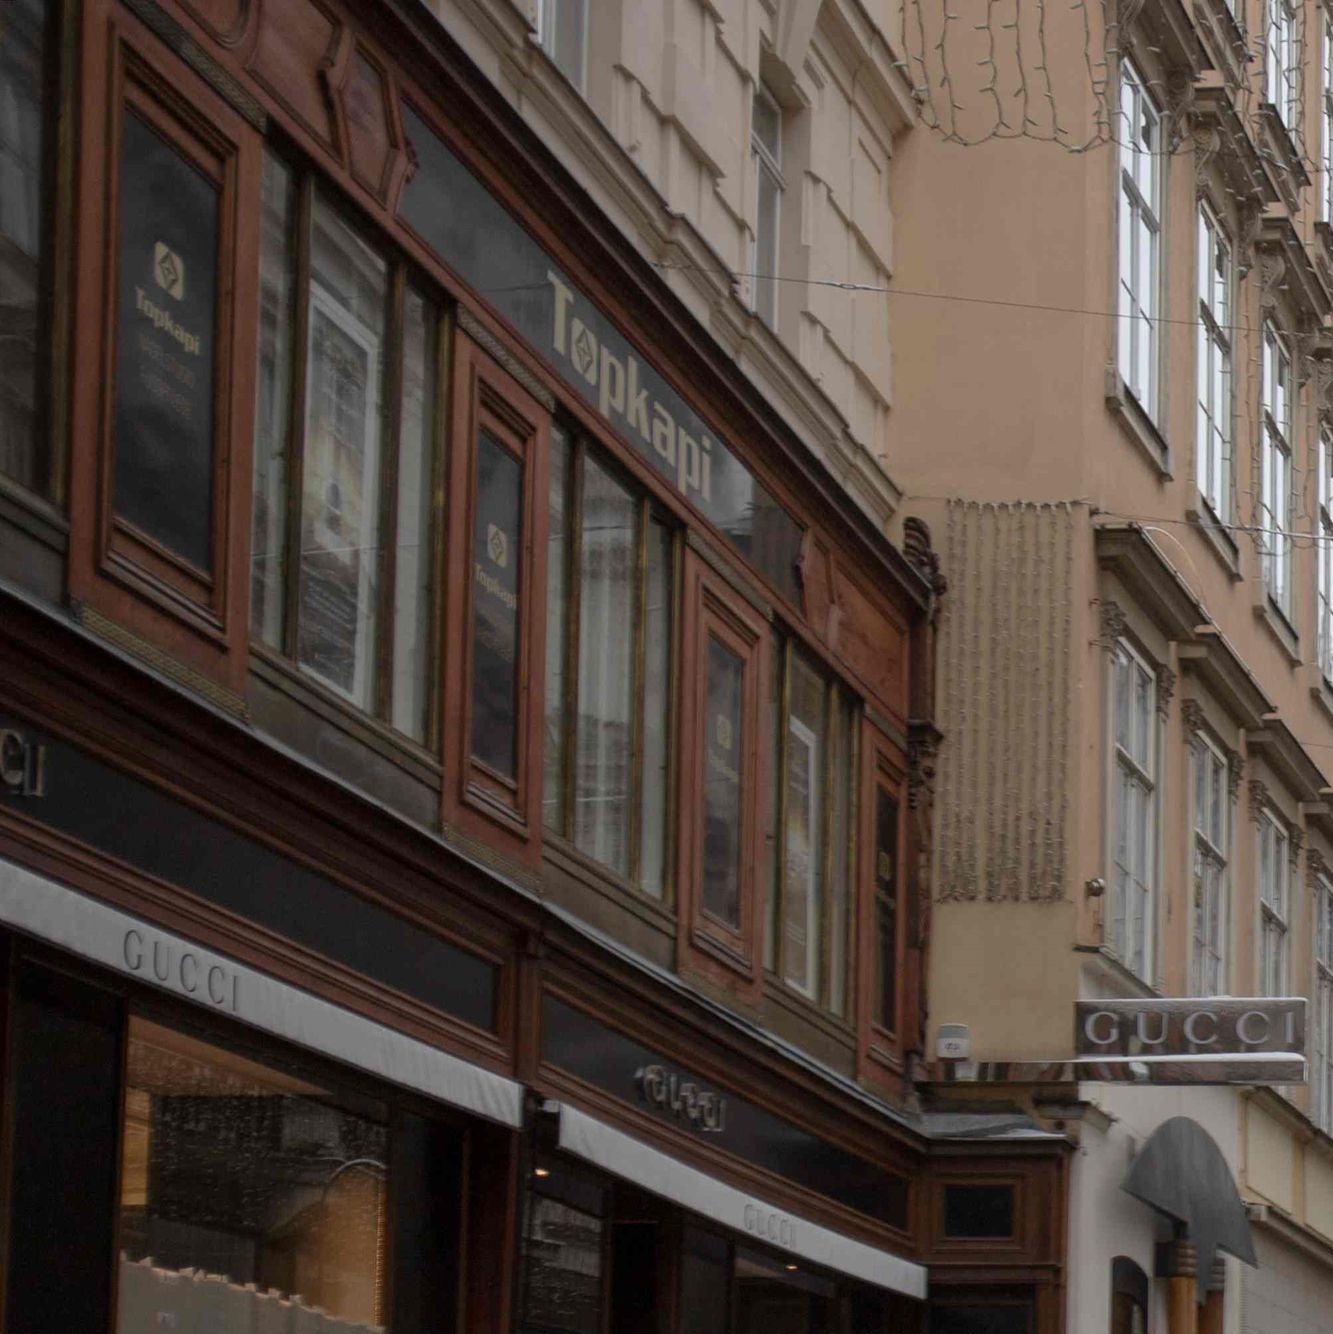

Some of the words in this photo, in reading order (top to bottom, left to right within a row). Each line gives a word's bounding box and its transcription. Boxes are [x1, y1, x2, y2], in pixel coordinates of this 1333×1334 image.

[135, 286, 199, 356] Topkapi
[547, 270, 711, 502] Topkapi
[122, 930, 240, 1012] GUCCI
[1084, 1010, 1295, 1045] GUCCI
[743, 1204, 796, 1249] GUCCI
